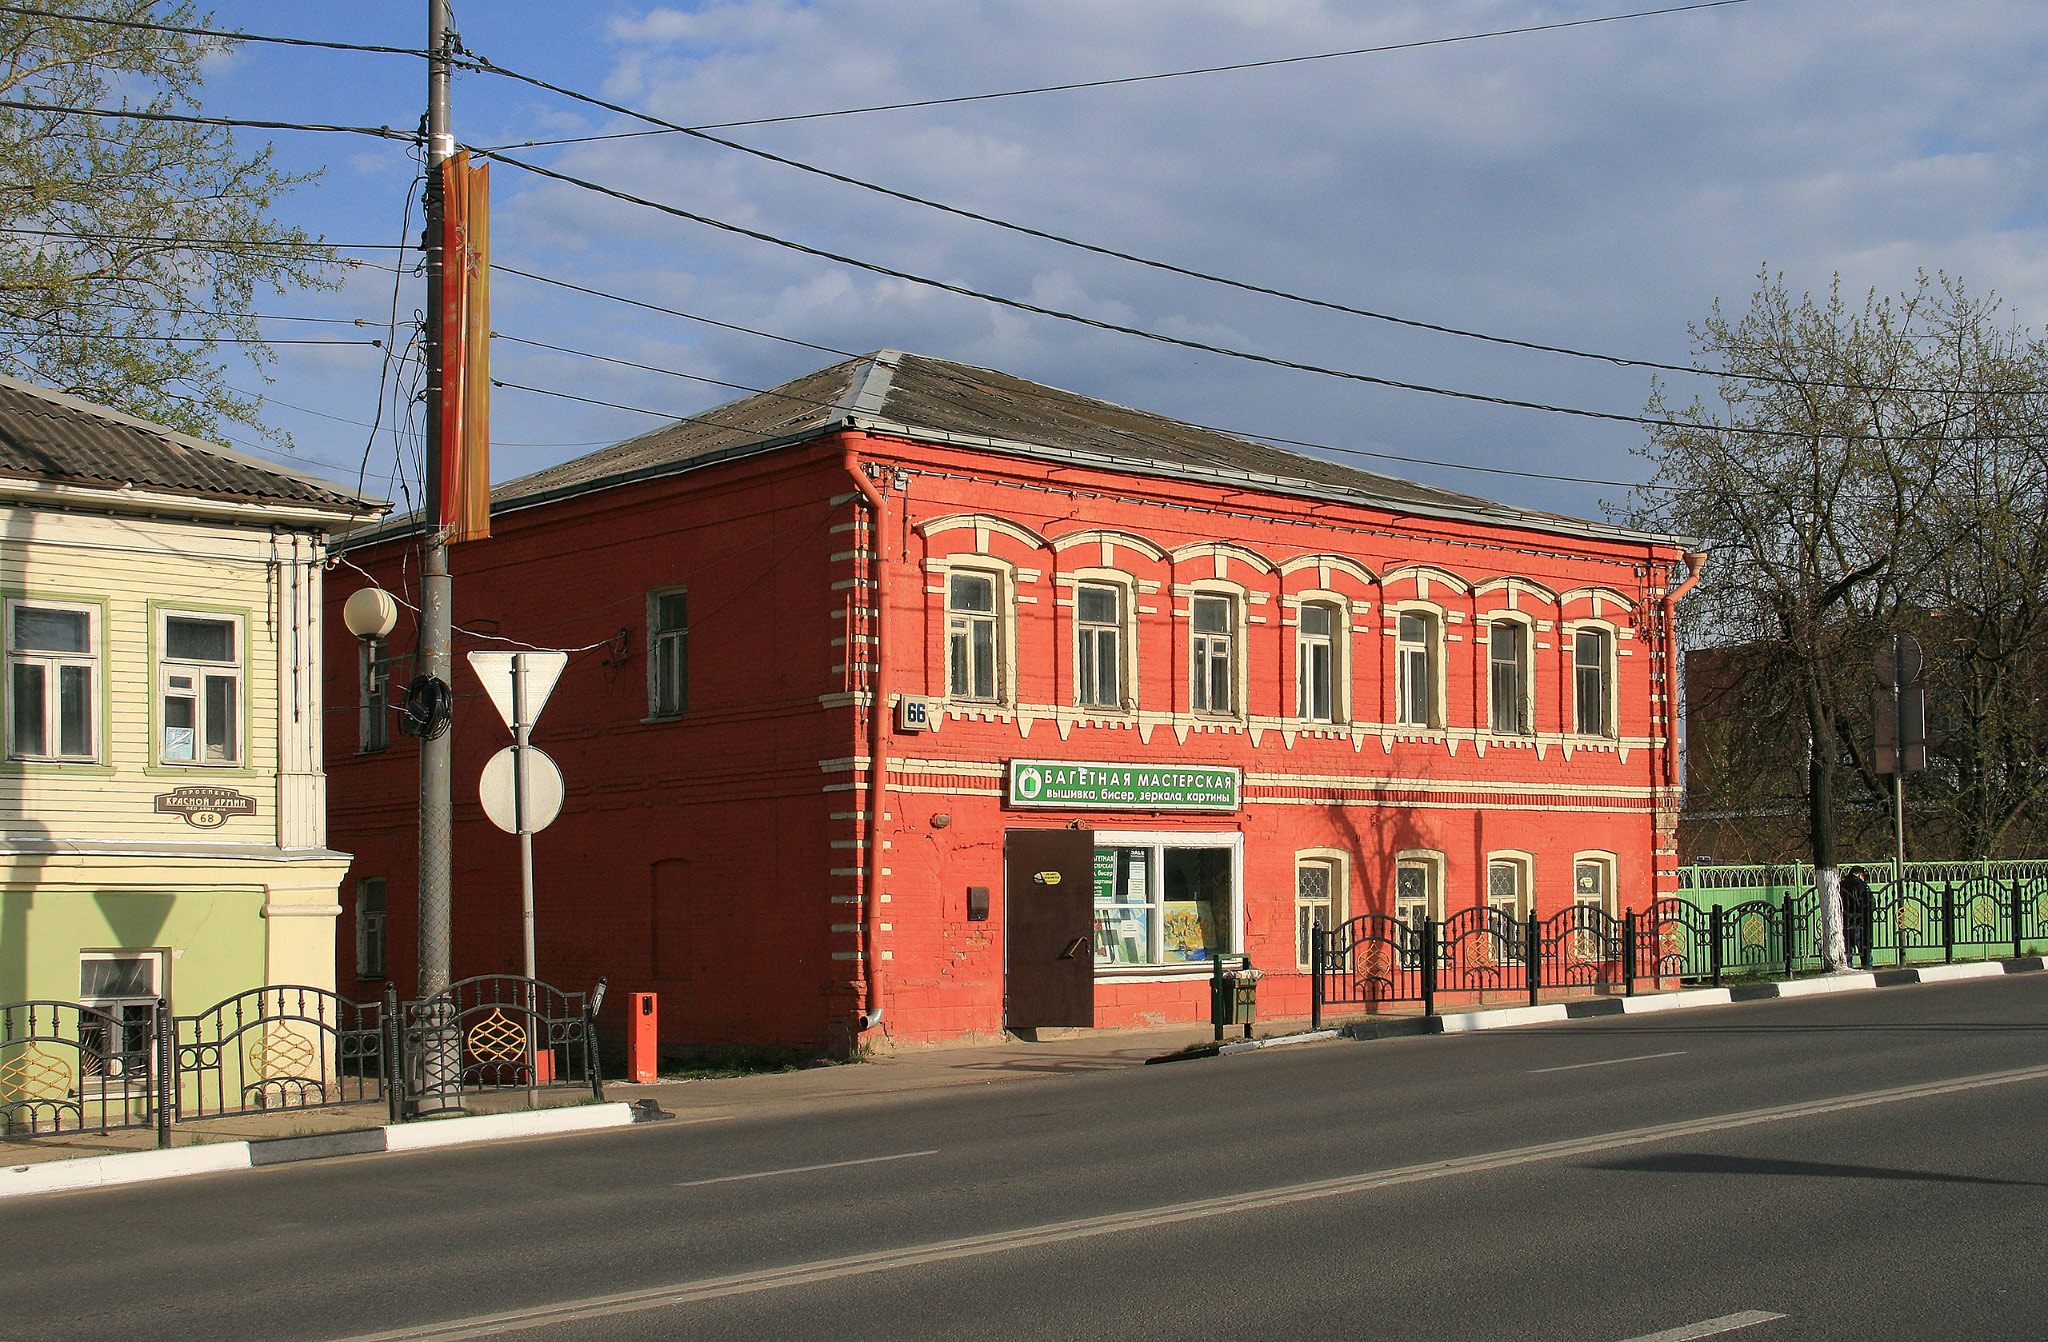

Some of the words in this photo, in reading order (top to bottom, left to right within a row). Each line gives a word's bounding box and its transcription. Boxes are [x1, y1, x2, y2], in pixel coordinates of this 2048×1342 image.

[907, 702, 926, 723] 66
[1044, 769, 1131, 787] БАГЕТНАЯ
[1137, 773, 1233, 789] МАСТЕРСКАЯ
[166, 797, 209, 806] КРАСНОЙ
[214, 798, 246, 807] АРМИИ
[1046, 789, 1098, 801] вышивка,
[1101, 788, 1137, 802] бисер,
[1139, 791, 1185, 803] зеркала,
[1186, 792, 1230, 804] картины
[200, 813, 214, 823] 68
